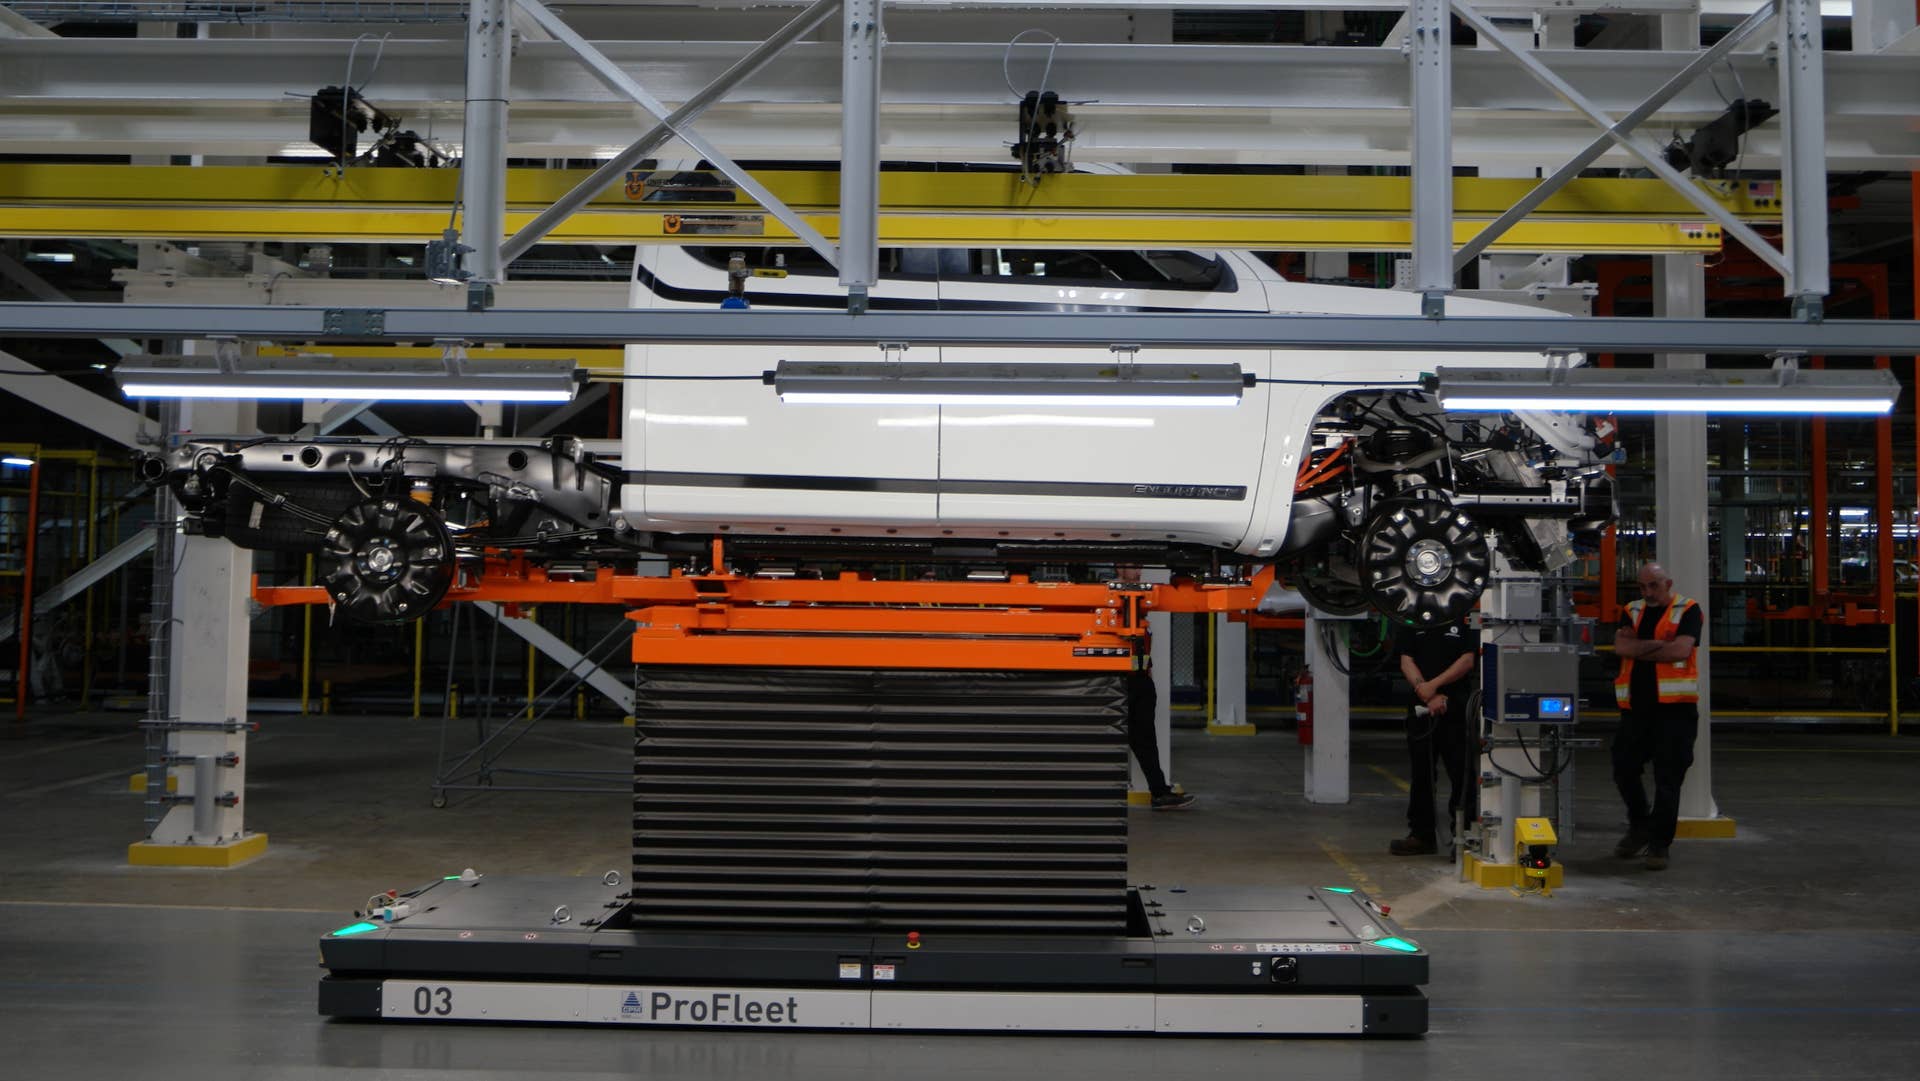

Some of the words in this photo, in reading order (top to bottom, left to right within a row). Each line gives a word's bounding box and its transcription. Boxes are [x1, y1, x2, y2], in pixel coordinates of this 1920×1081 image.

[1134, 484, 1241, 497] ENDURANCE
[414, 986, 453, 1016] 03
[651, 991, 798, 1024] ProFleet
